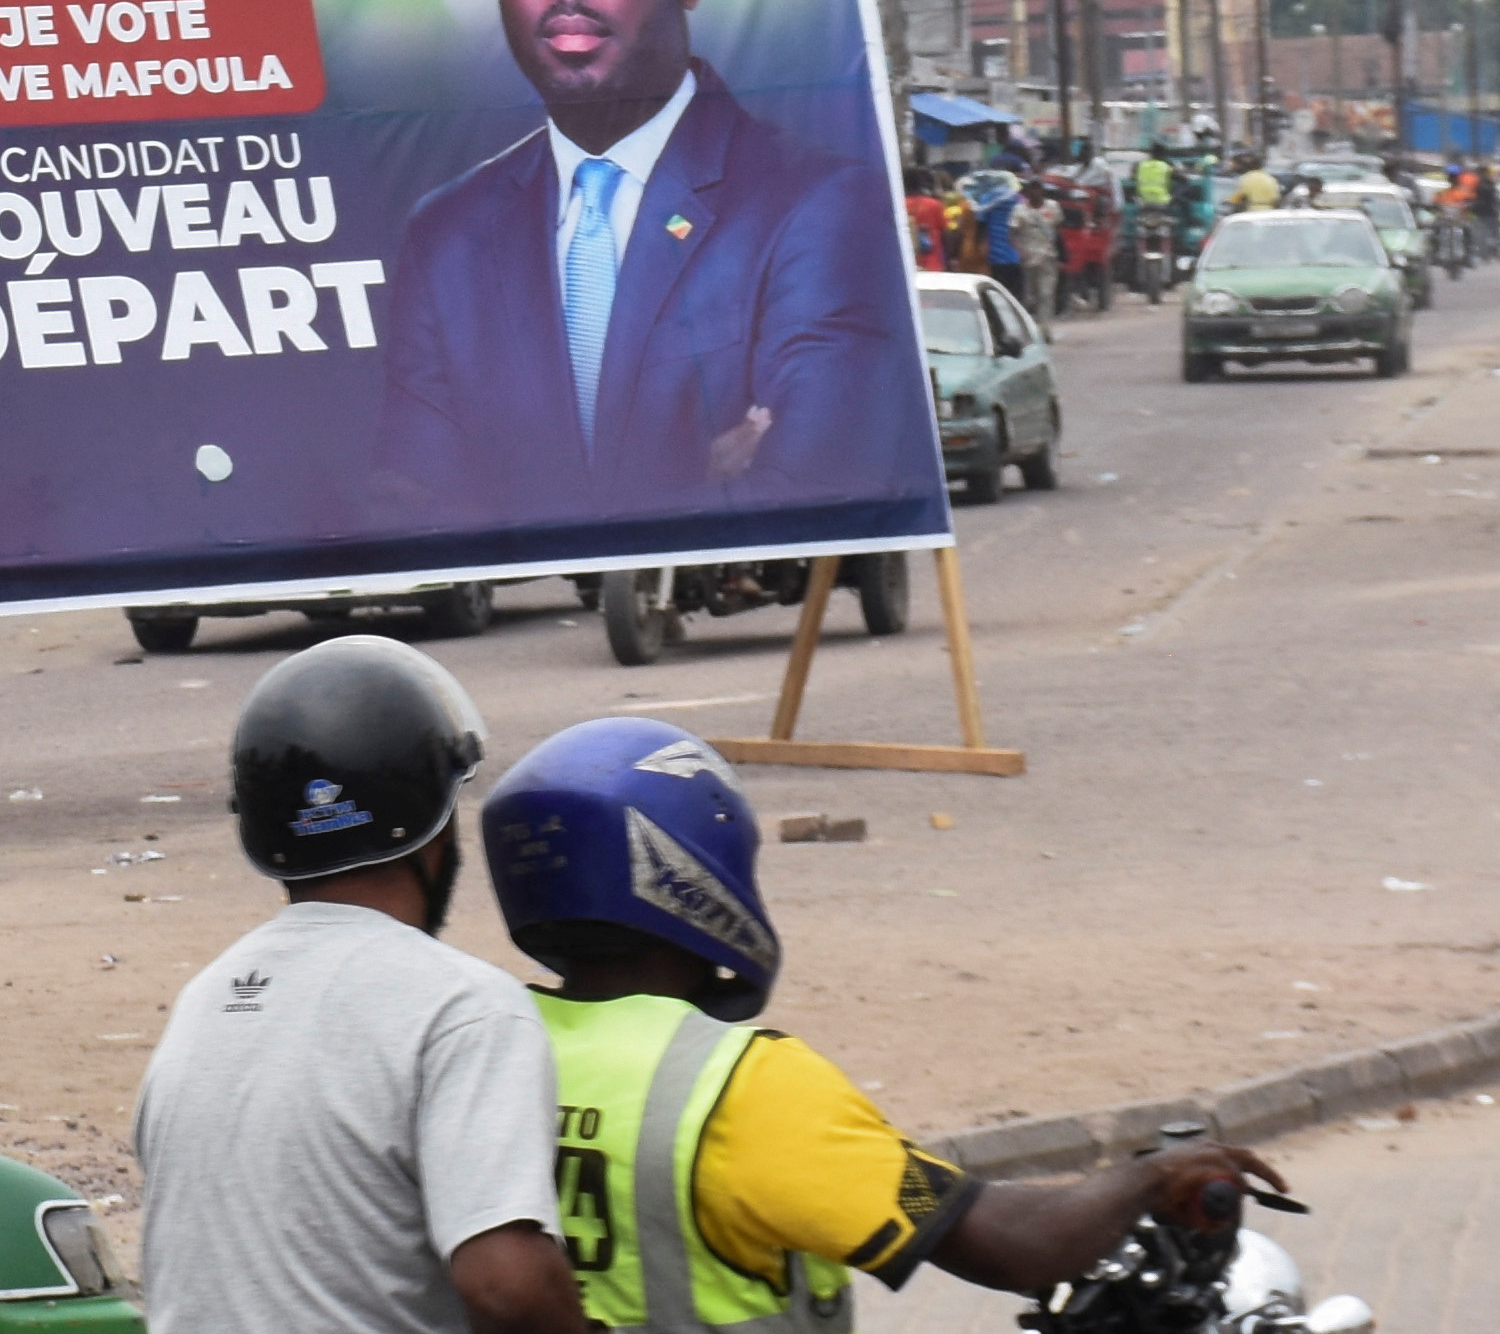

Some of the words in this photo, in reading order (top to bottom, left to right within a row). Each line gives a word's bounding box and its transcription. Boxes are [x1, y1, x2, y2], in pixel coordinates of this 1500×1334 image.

[67, 0, 210, 44] VOTE
[62, 55, 294, 99] MAFOULA
[0, 137, 225, 183] CANDIDAT
[237, 133, 302, 171] DU
[557, 1105, 601, 1140] TO
